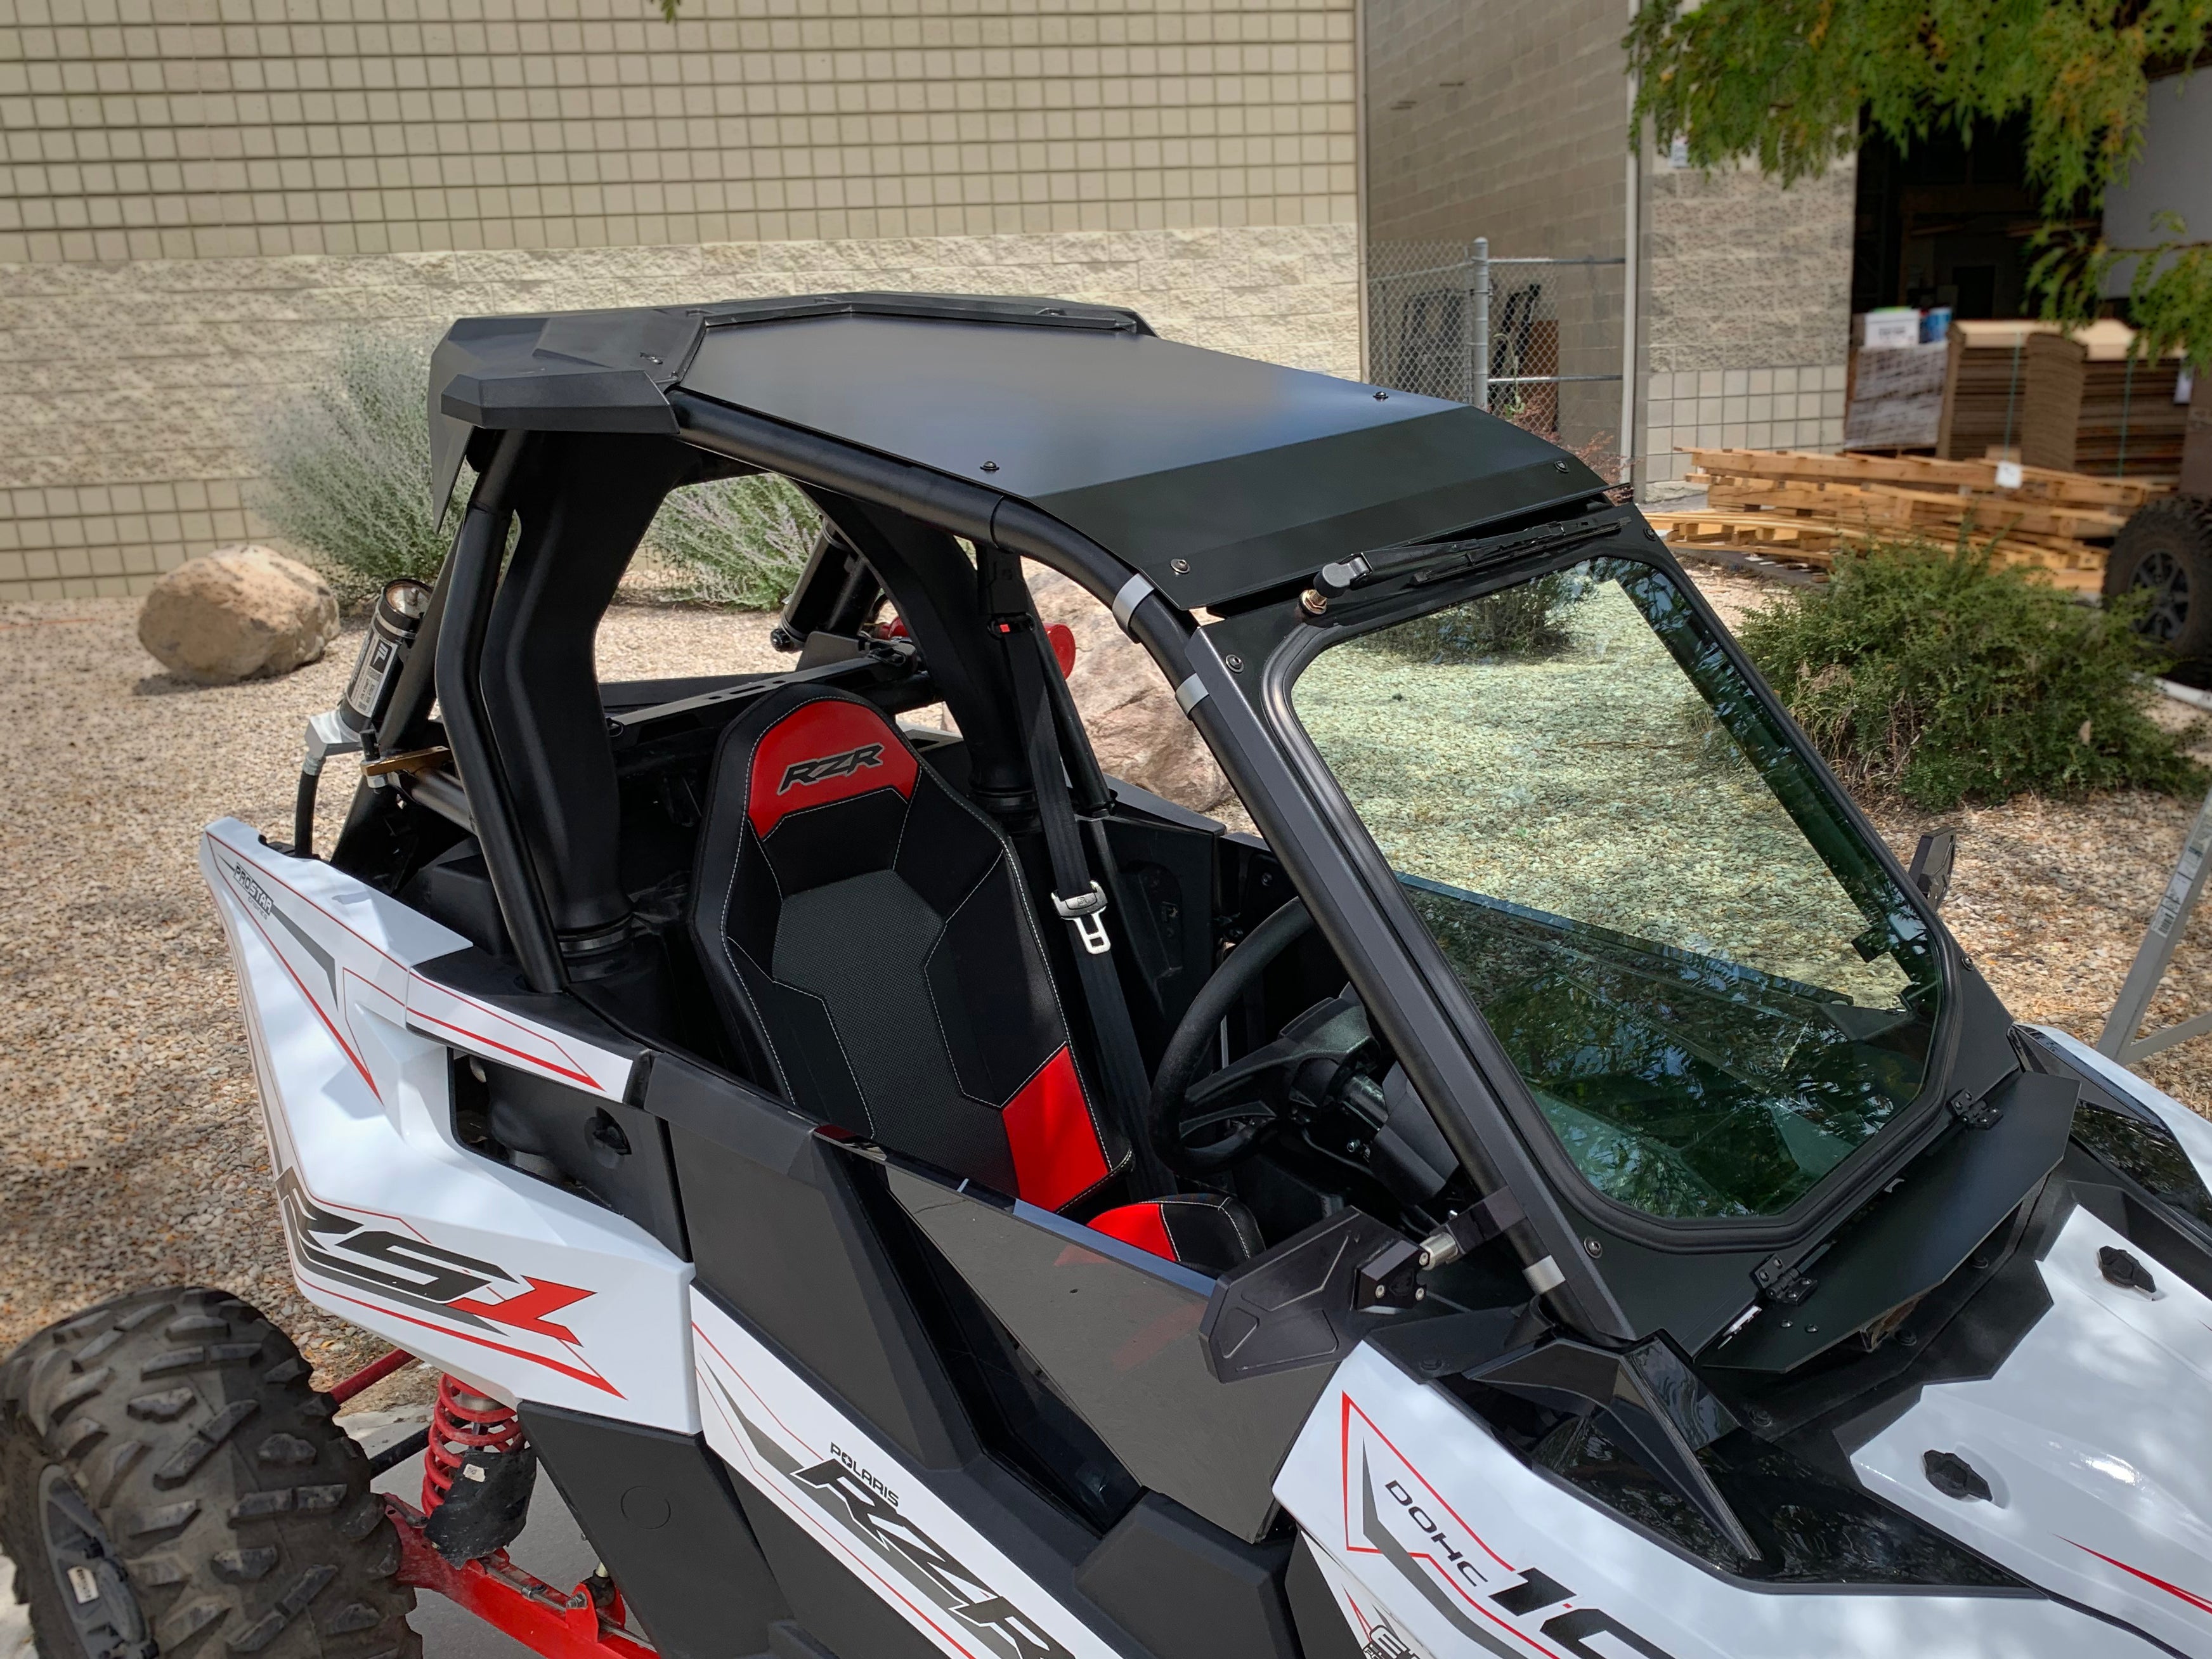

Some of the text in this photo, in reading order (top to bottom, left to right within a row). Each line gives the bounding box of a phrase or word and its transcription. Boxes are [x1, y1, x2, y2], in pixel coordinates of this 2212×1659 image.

[777, 743, 884, 795] RZR
[234, 864, 273, 915] PROSTAR
[830, 1441, 899, 1507] POLARIS
[790, 1457, 1077, 1659] RZR
[1385, 1480, 1488, 1587] DOHC
